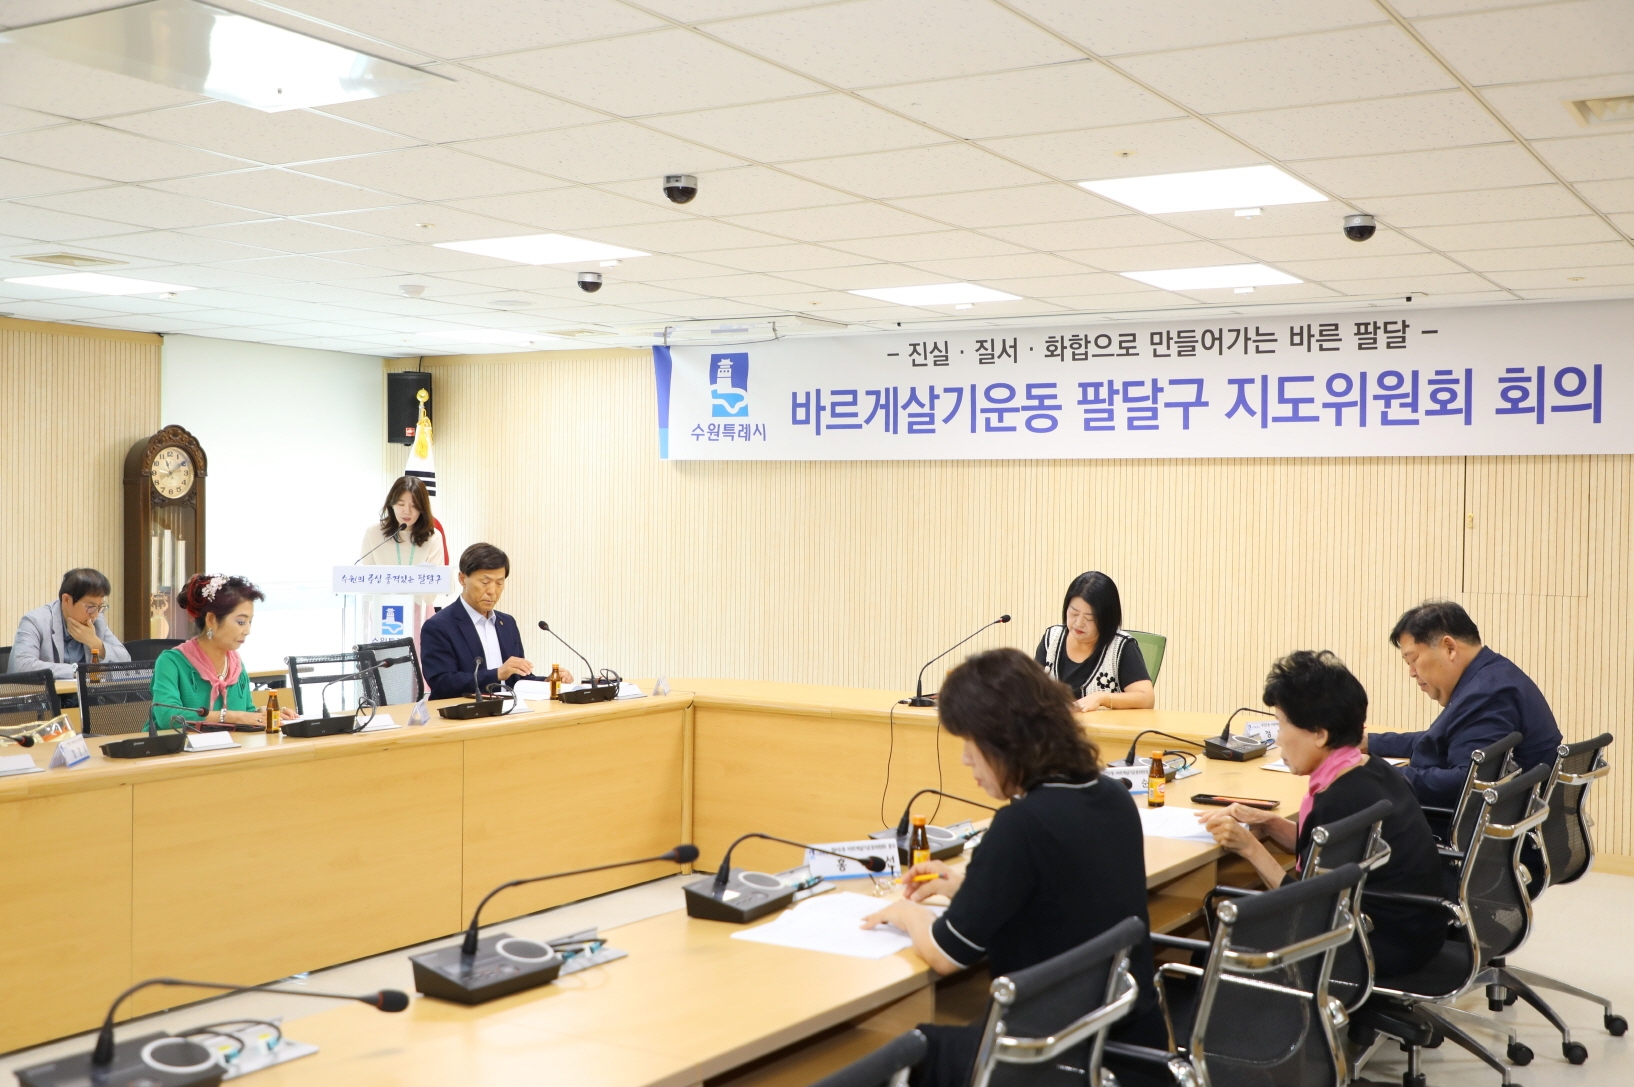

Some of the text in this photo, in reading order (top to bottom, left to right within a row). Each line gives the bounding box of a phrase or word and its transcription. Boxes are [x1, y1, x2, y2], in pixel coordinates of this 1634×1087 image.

[908, 319, 1410, 368] 진실 질서 화합으로 만들어가는 바른 팔달
[791, 363, 1603, 436] 바르게살기운동 팔달구 지도위원회 회의
[690, 423, 767, 442] 수원특례시
[341, 573, 365, 585] 수원의
[367, 573, 382, 585] 중심
[417, 573, 443, 585] 팔달구
